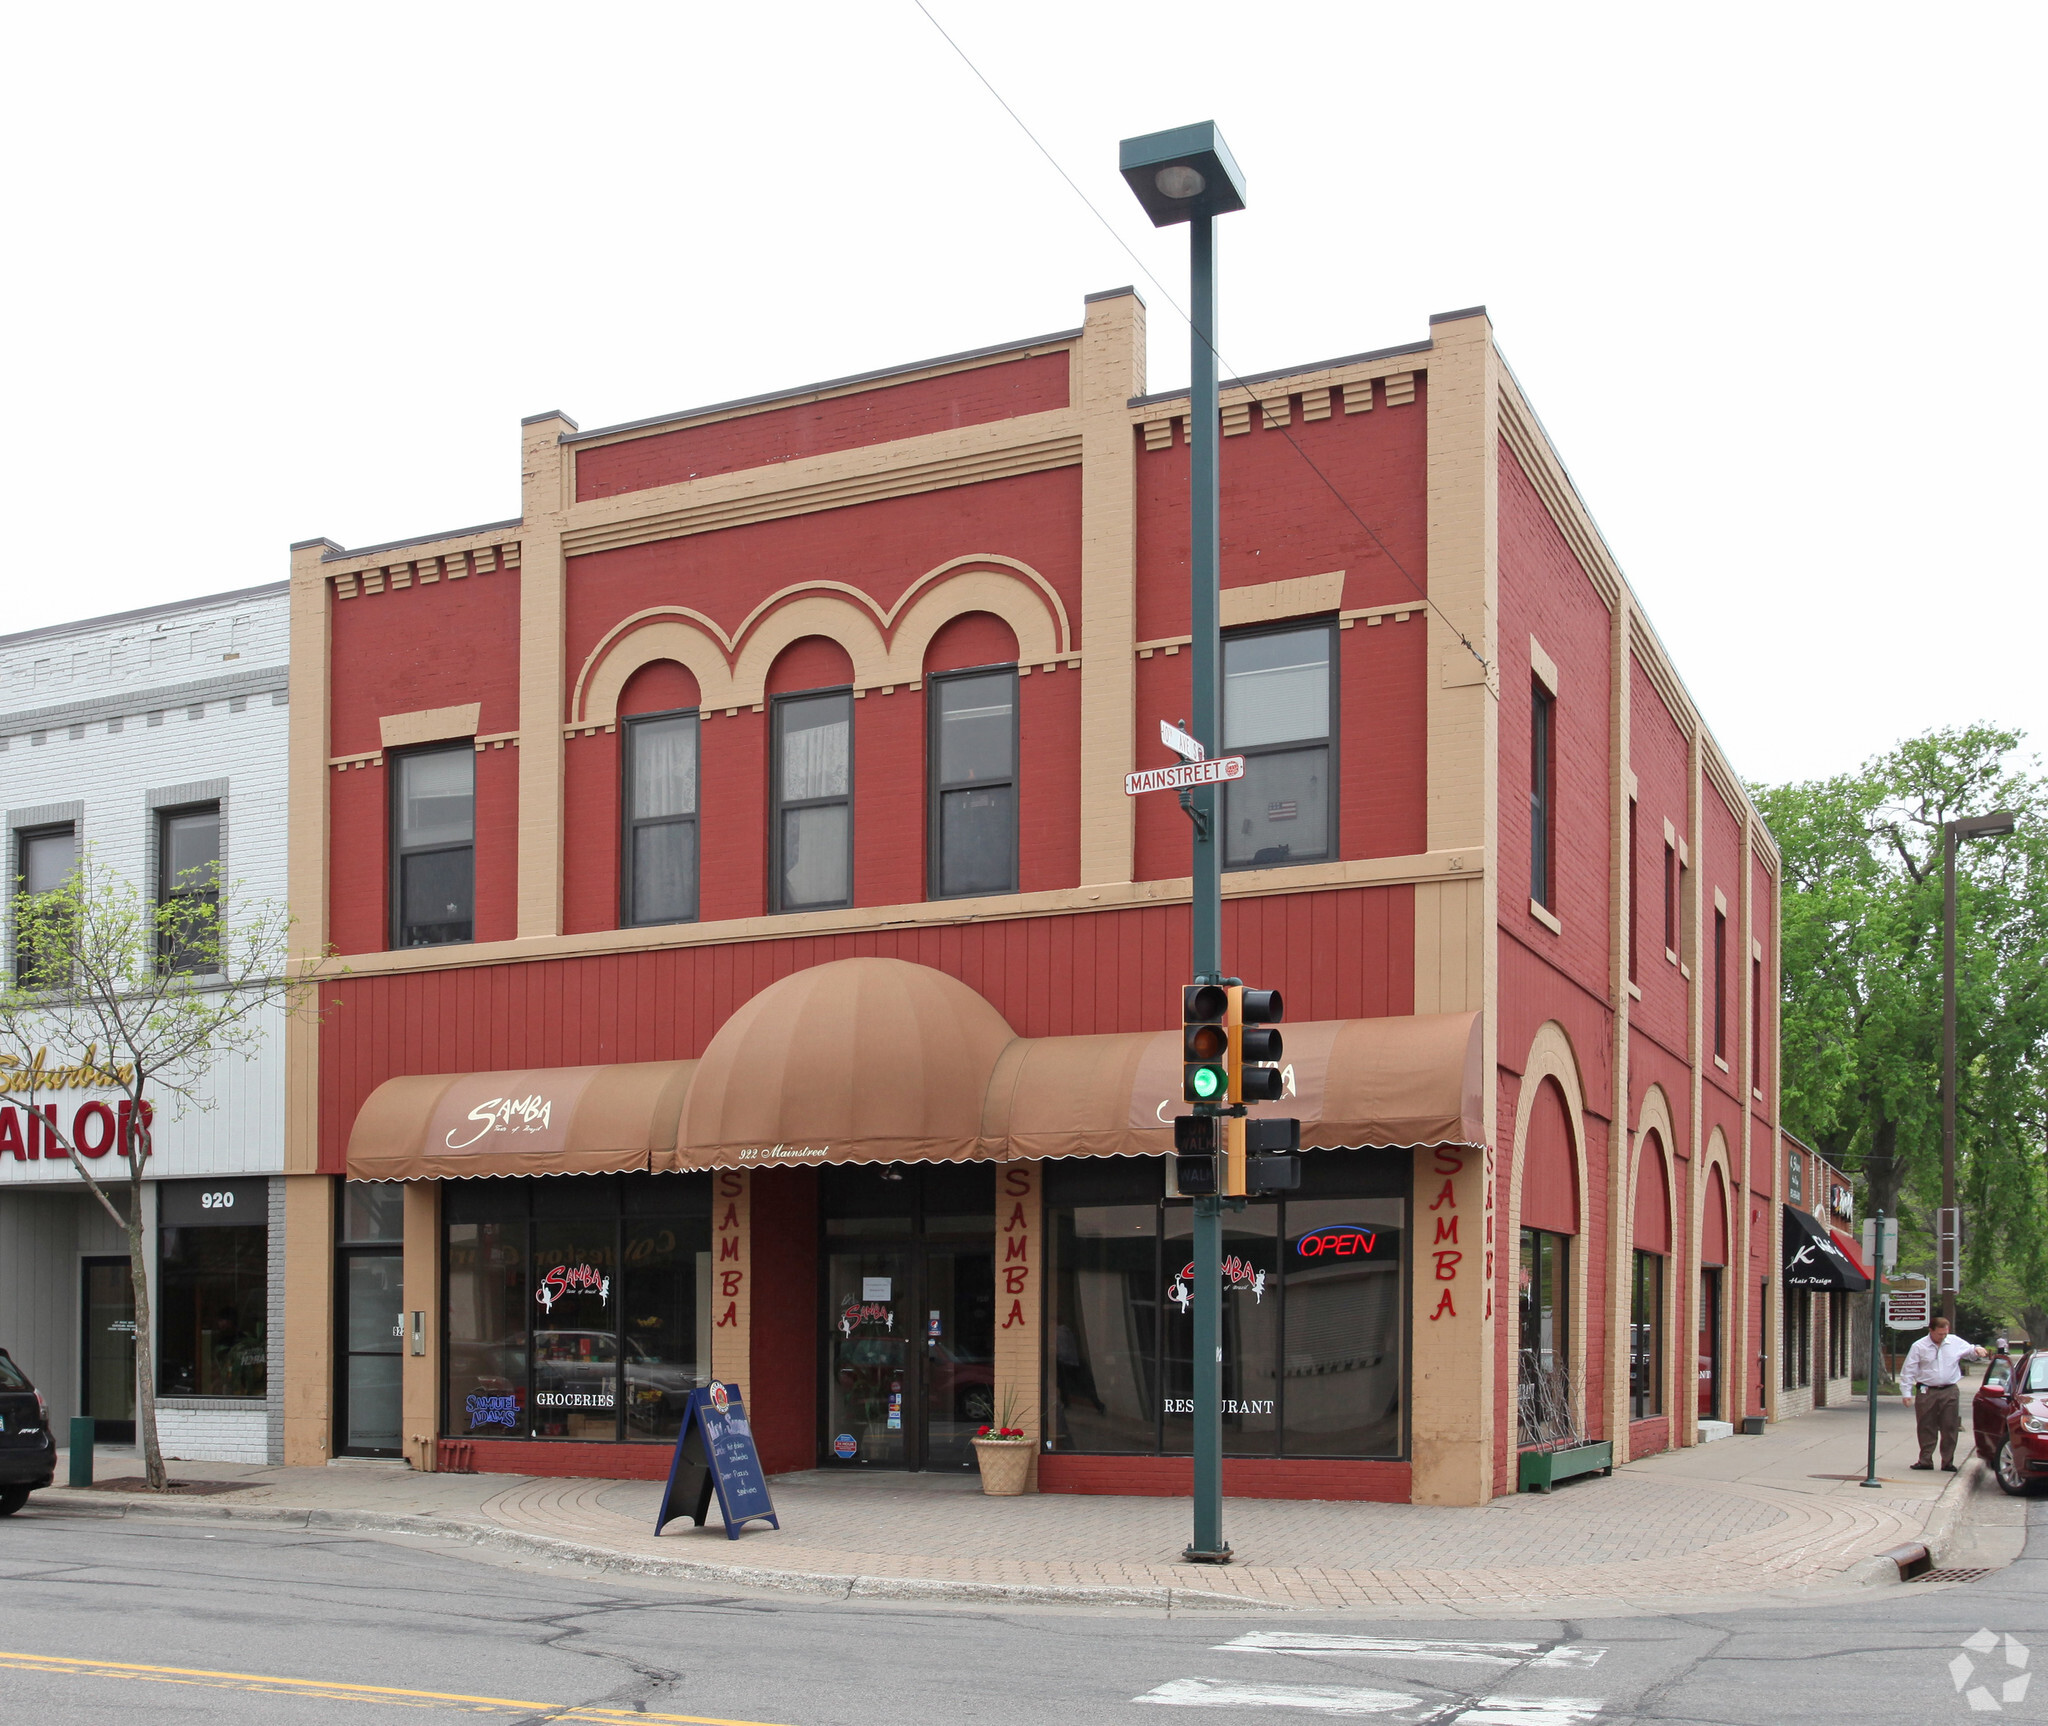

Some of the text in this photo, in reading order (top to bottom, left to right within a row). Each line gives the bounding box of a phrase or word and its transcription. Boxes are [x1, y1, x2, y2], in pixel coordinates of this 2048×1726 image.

[1131, 762, 1221, 792] MAINSTREET
[0, 1043, 134, 1093] Suburban
[446, 1094, 551, 1149] SAMBA
[739, 1143, 829, 1160] 922 Mainstreet
[201, 1191, 234, 1208] 920
[1300, 1233, 1376, 1256] OPEN
[1429, 1146, 1463, 1321] SAMBA
[717, 1171, 743, 1328] SAMBA
[1001, 1168, 1031, 1329] SAMBA
[536, 1263, 602, 1304] SAMBA
[1168, 1255, 1256, 1302] SMBA
[1808, 1276, 1832, 1286] Design
[838, 1303, 888, 1332] SAMBA
[466, 1394, 520, 1413] SAMUEL
[536, 1392, 614, 1407] GROCERIES
[1164, 1399, 1274, 1414] RESRANT
[470, 1410, 516, 1429] ADAMS
